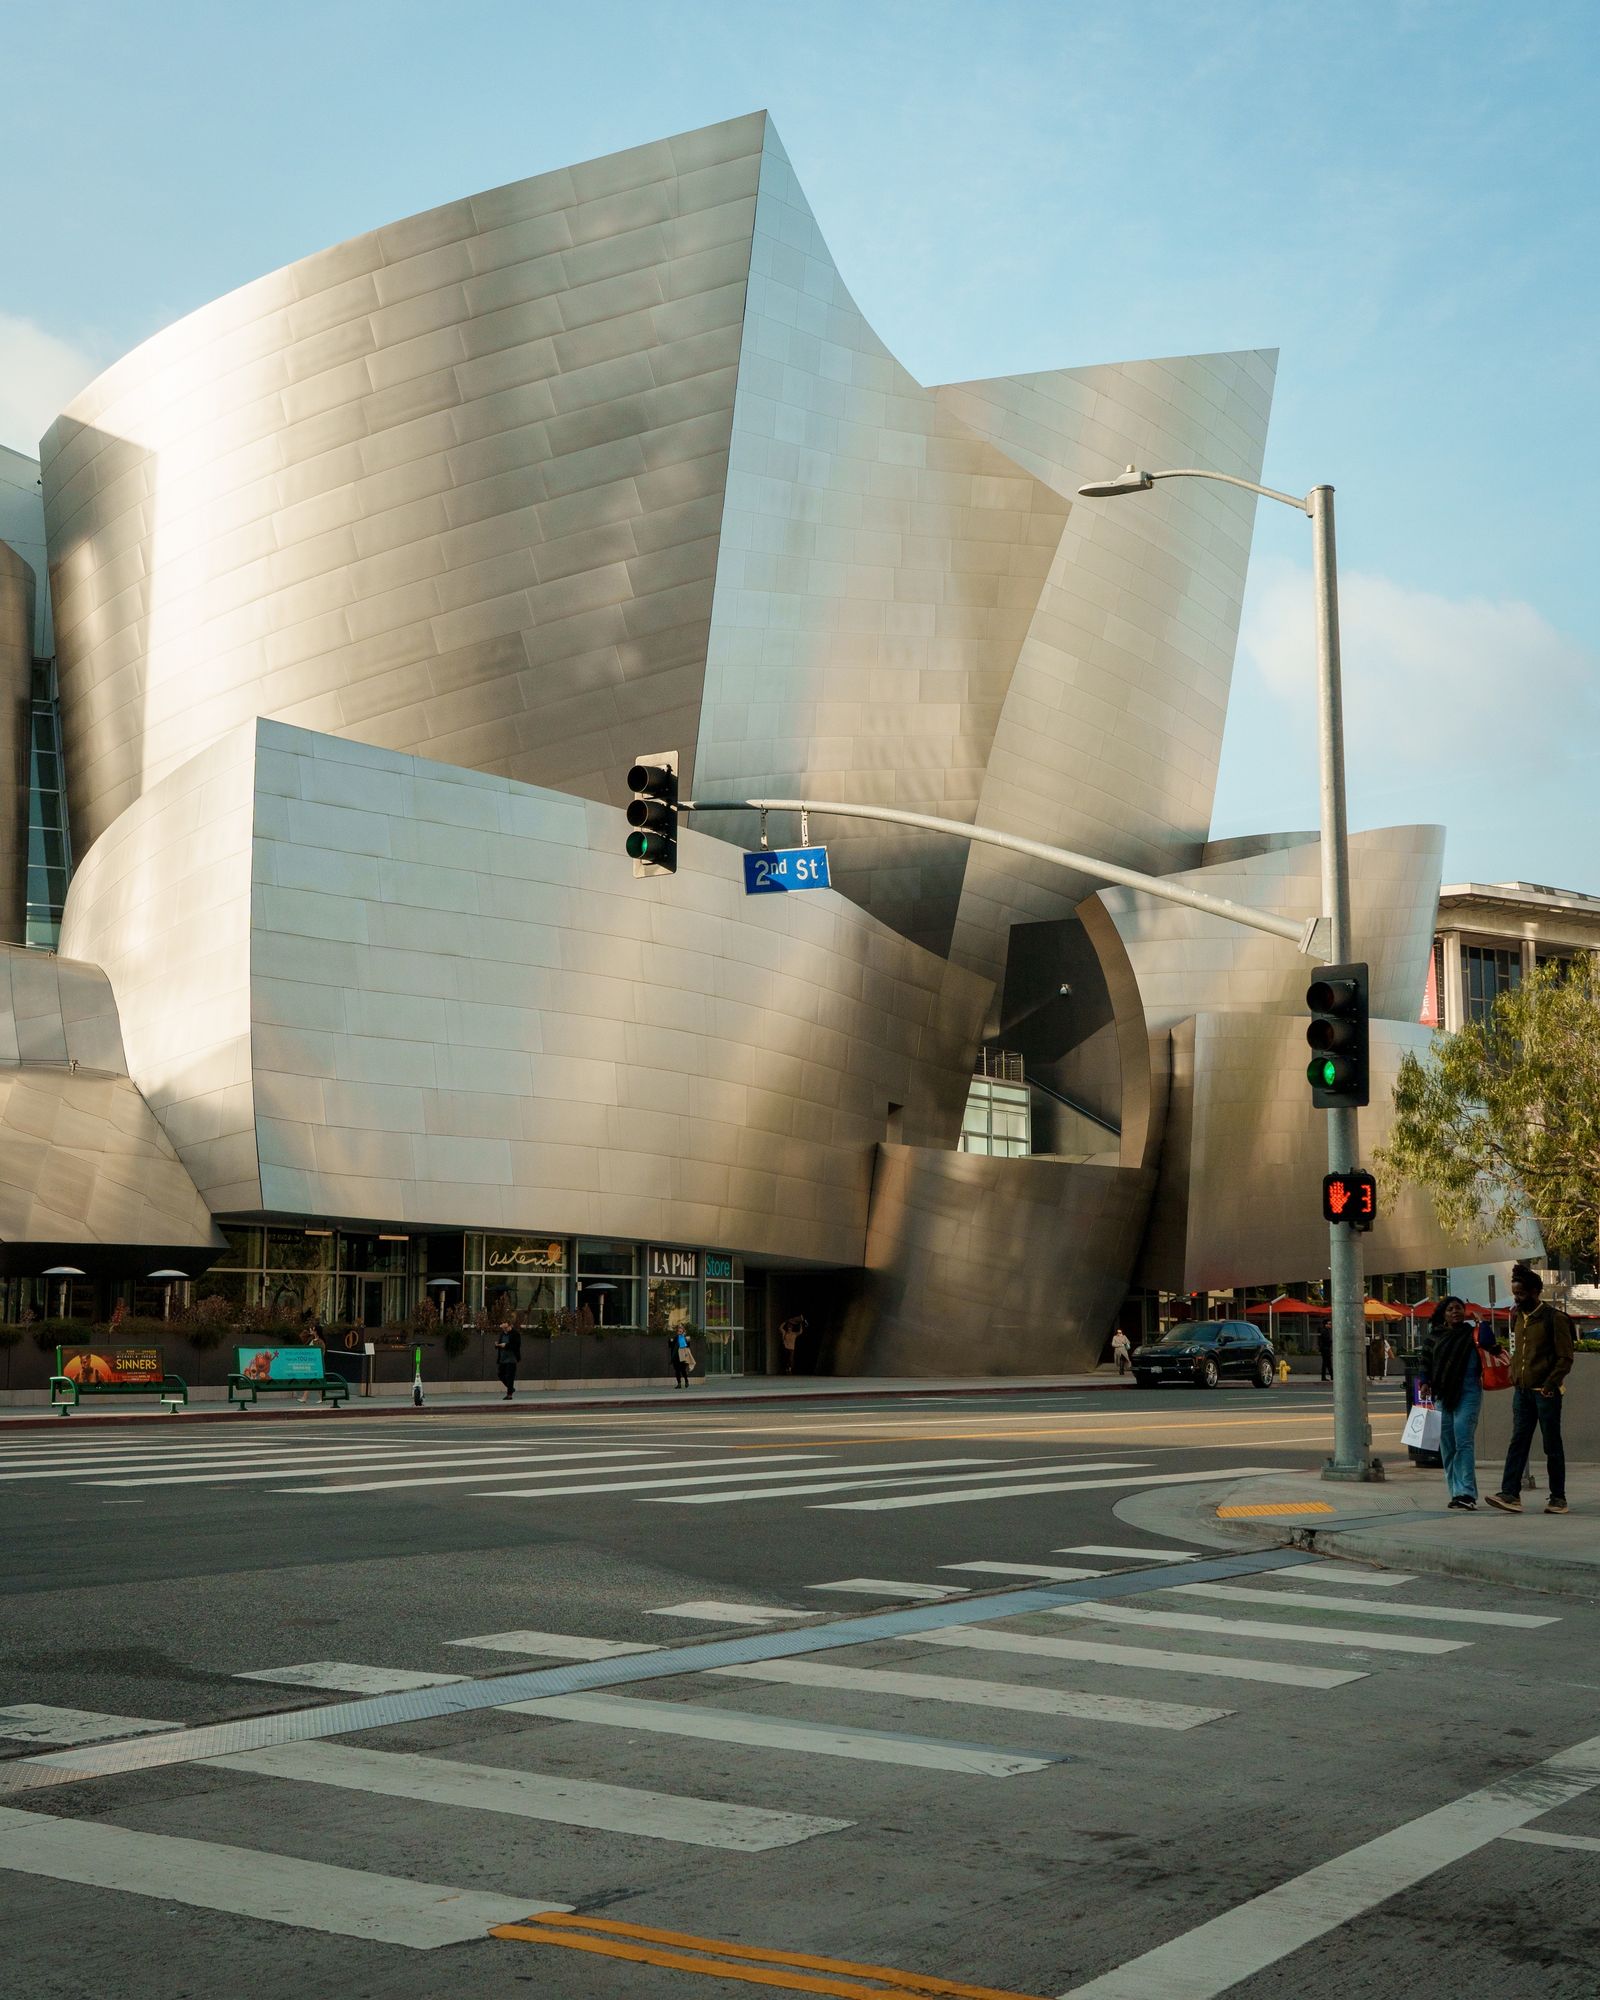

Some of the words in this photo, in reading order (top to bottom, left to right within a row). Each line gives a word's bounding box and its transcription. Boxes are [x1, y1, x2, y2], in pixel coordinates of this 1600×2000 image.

[755, 859, 787, 886] 2nd
[796, 858, 819, 880] St
[1361, 1184, 1371, 1212] 3
[654, 1251, 669, 1275] LA
[672, 1252, 696, 1276] Phil
[706, 1255, 730, 1277] Store
[116, 1359, 157, 1370] SINNERS
